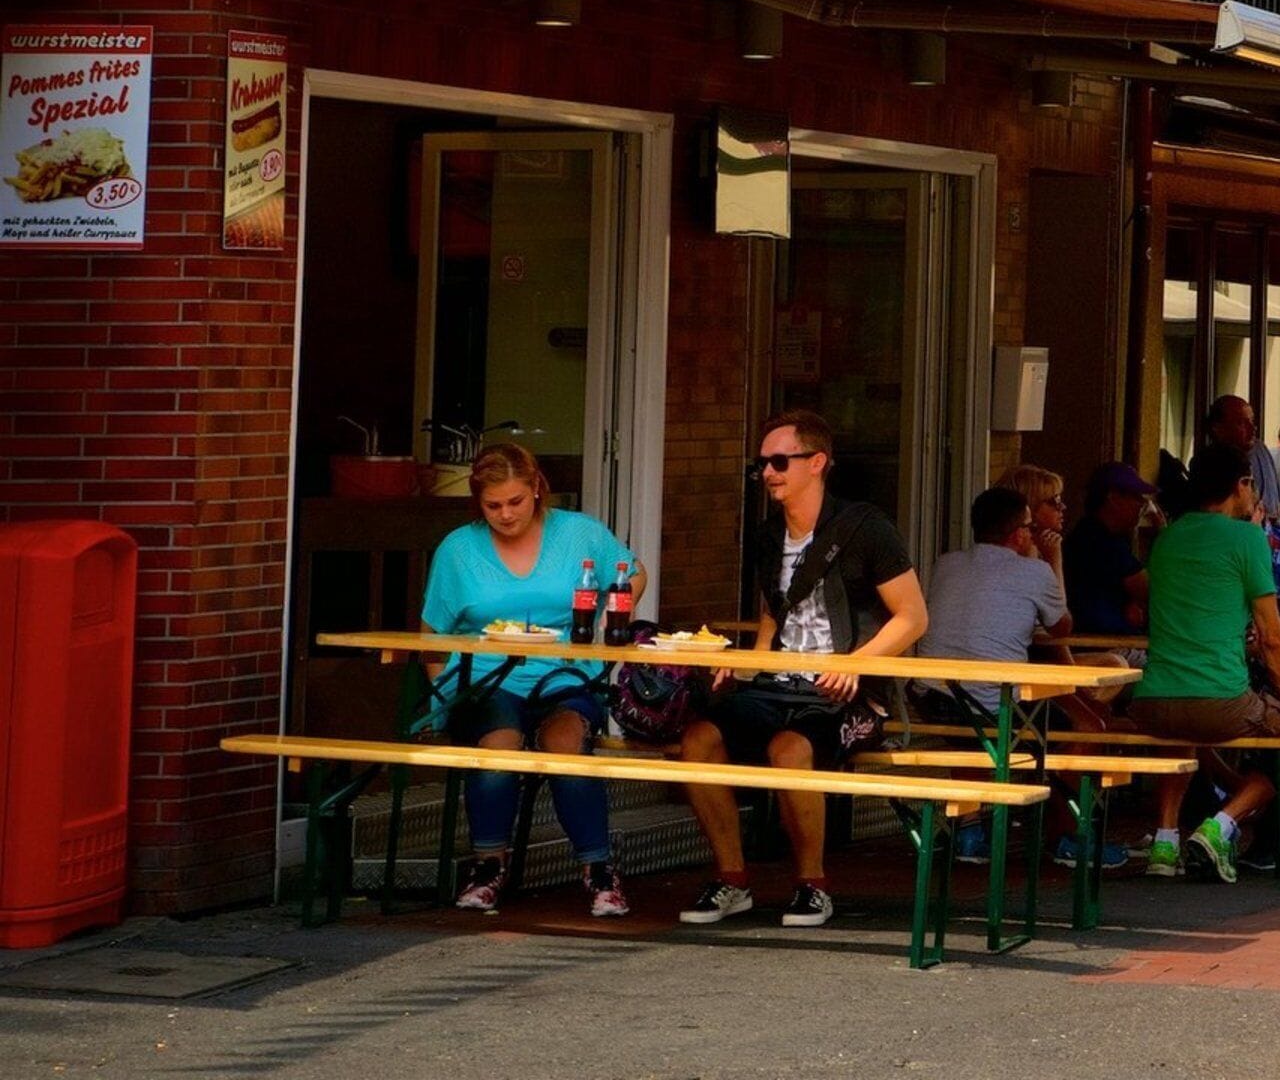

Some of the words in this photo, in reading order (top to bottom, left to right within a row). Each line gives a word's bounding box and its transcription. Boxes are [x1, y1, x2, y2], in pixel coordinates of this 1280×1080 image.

[11, 32, 146, 49] wurstmeister
[9, 67, 84, 98] Pommes
[89, 59, 140, 84] frites
[27, 85, 129, 132] Spezial
